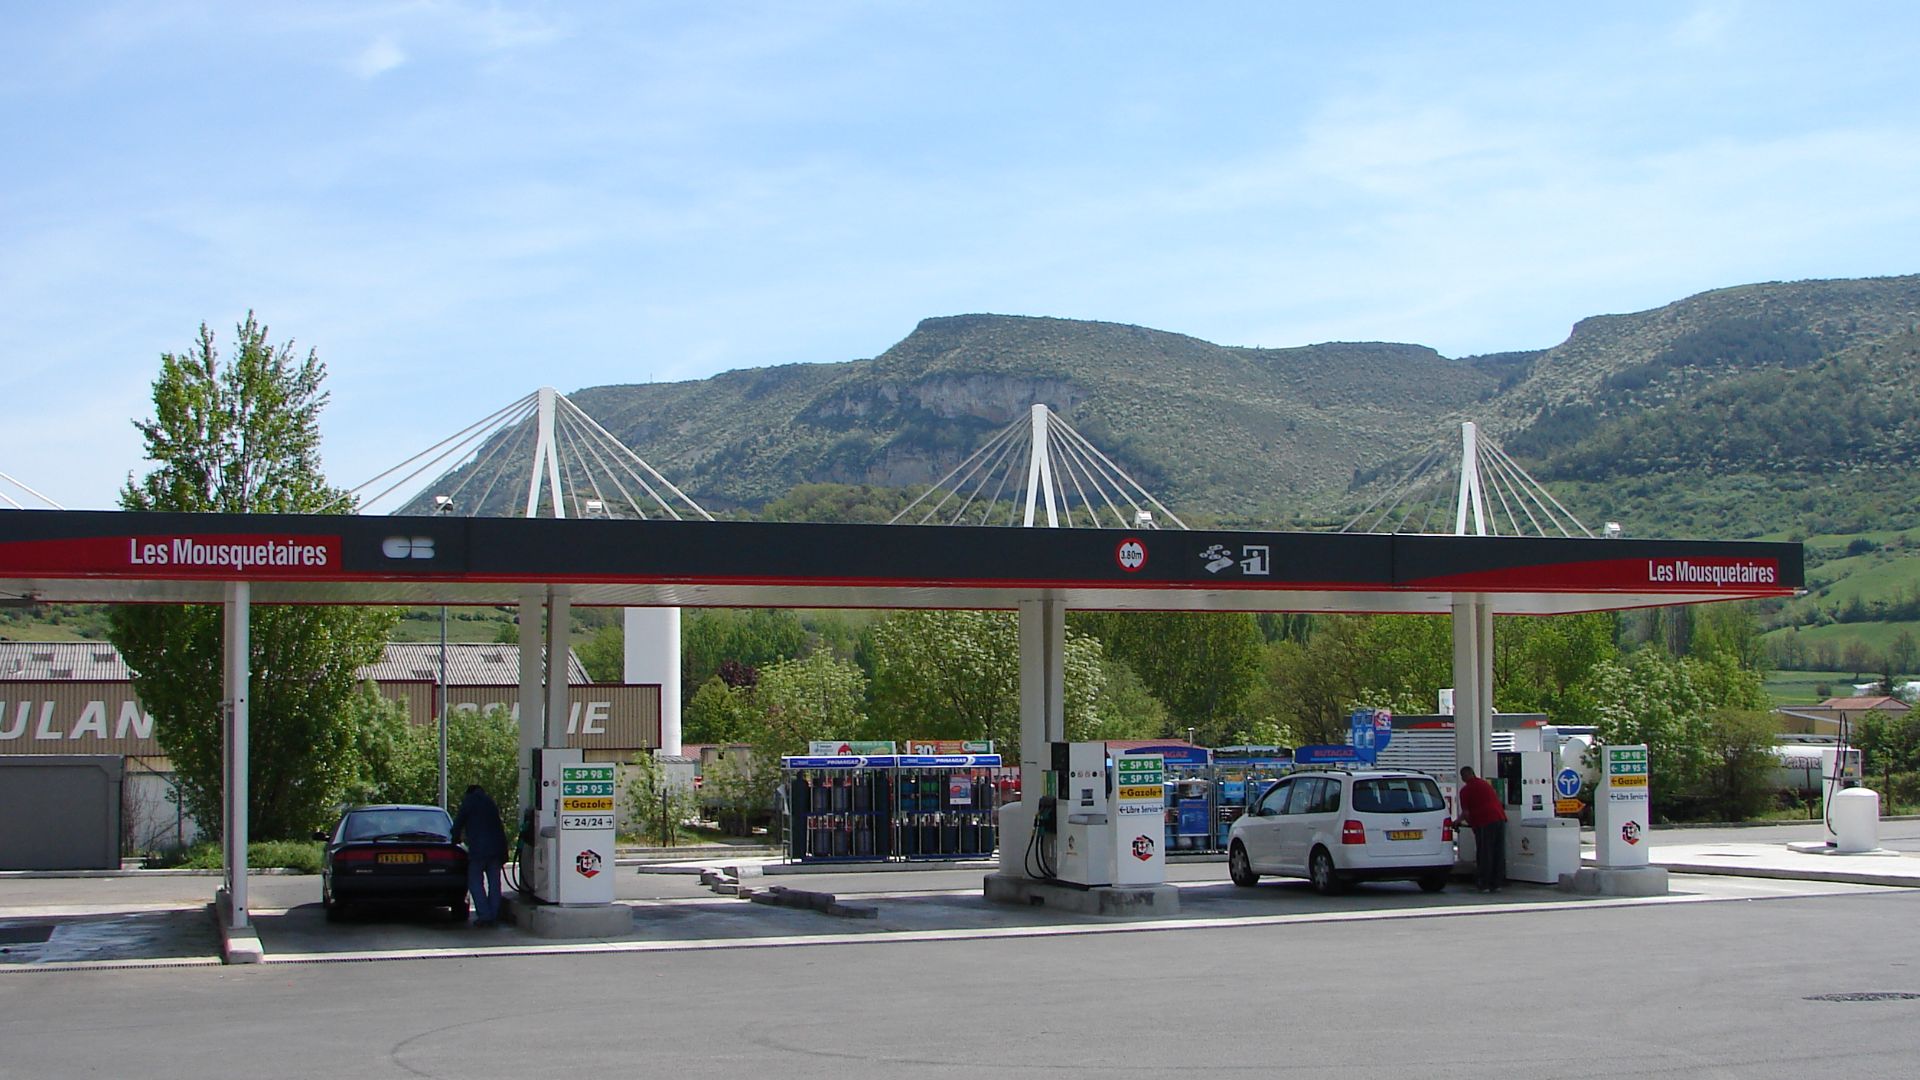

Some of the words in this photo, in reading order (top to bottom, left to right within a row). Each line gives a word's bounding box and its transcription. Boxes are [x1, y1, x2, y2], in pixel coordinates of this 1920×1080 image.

[130, 538, 168, 565] Les
[172, 538, 327, 571] Mousquetaires
[1120, 550, 1142, 560] 3.80m
[1648, 560, 1673, 582] Les
[1675, 560, 1774, 587] Mousquetaires
[1620, 751, 1630, 760] SP
[1130, 761, 1142, 769] SP
[1143, 760, 1154, 769] 98
[1620, 764, 1630, 772] SP
[575, 770, 588, 779] SP
[590, 770, 603, 779] 98
[1130, 775, 1142, 783] SP
[1143, 774, 1154, 783] 95
[575, 785, 588, 794] SP
[590, 785, 603, 794] 95
[1127, 788, 1157, 797] Gazole
[571, 800, 606, 809] Gazole
[574, 818, 603, 827] 24/24
